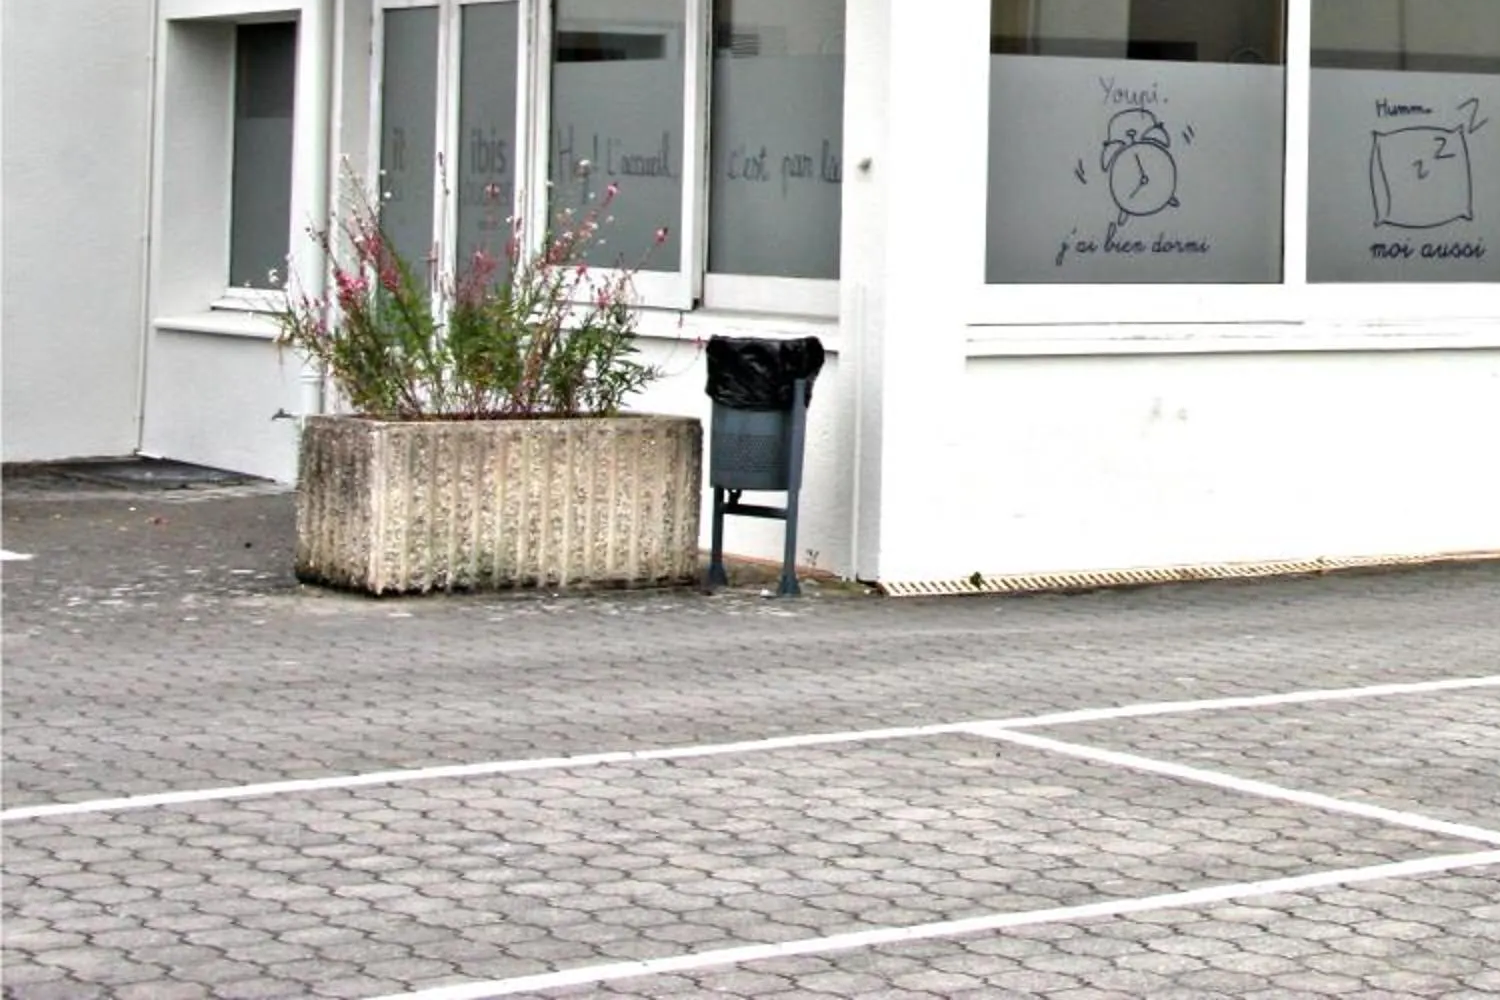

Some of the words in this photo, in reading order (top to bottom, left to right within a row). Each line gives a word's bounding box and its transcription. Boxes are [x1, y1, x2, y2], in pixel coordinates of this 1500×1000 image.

[470, 125, 508, 175] ibis
[780, 151, 814, 202] par
[1103, 222, 1147, 253] bien
[1150, 232, 1212, 254] dormi
[1369, 236, 1415, 260] moi
[1420, 236, 1487, 260] aussi
